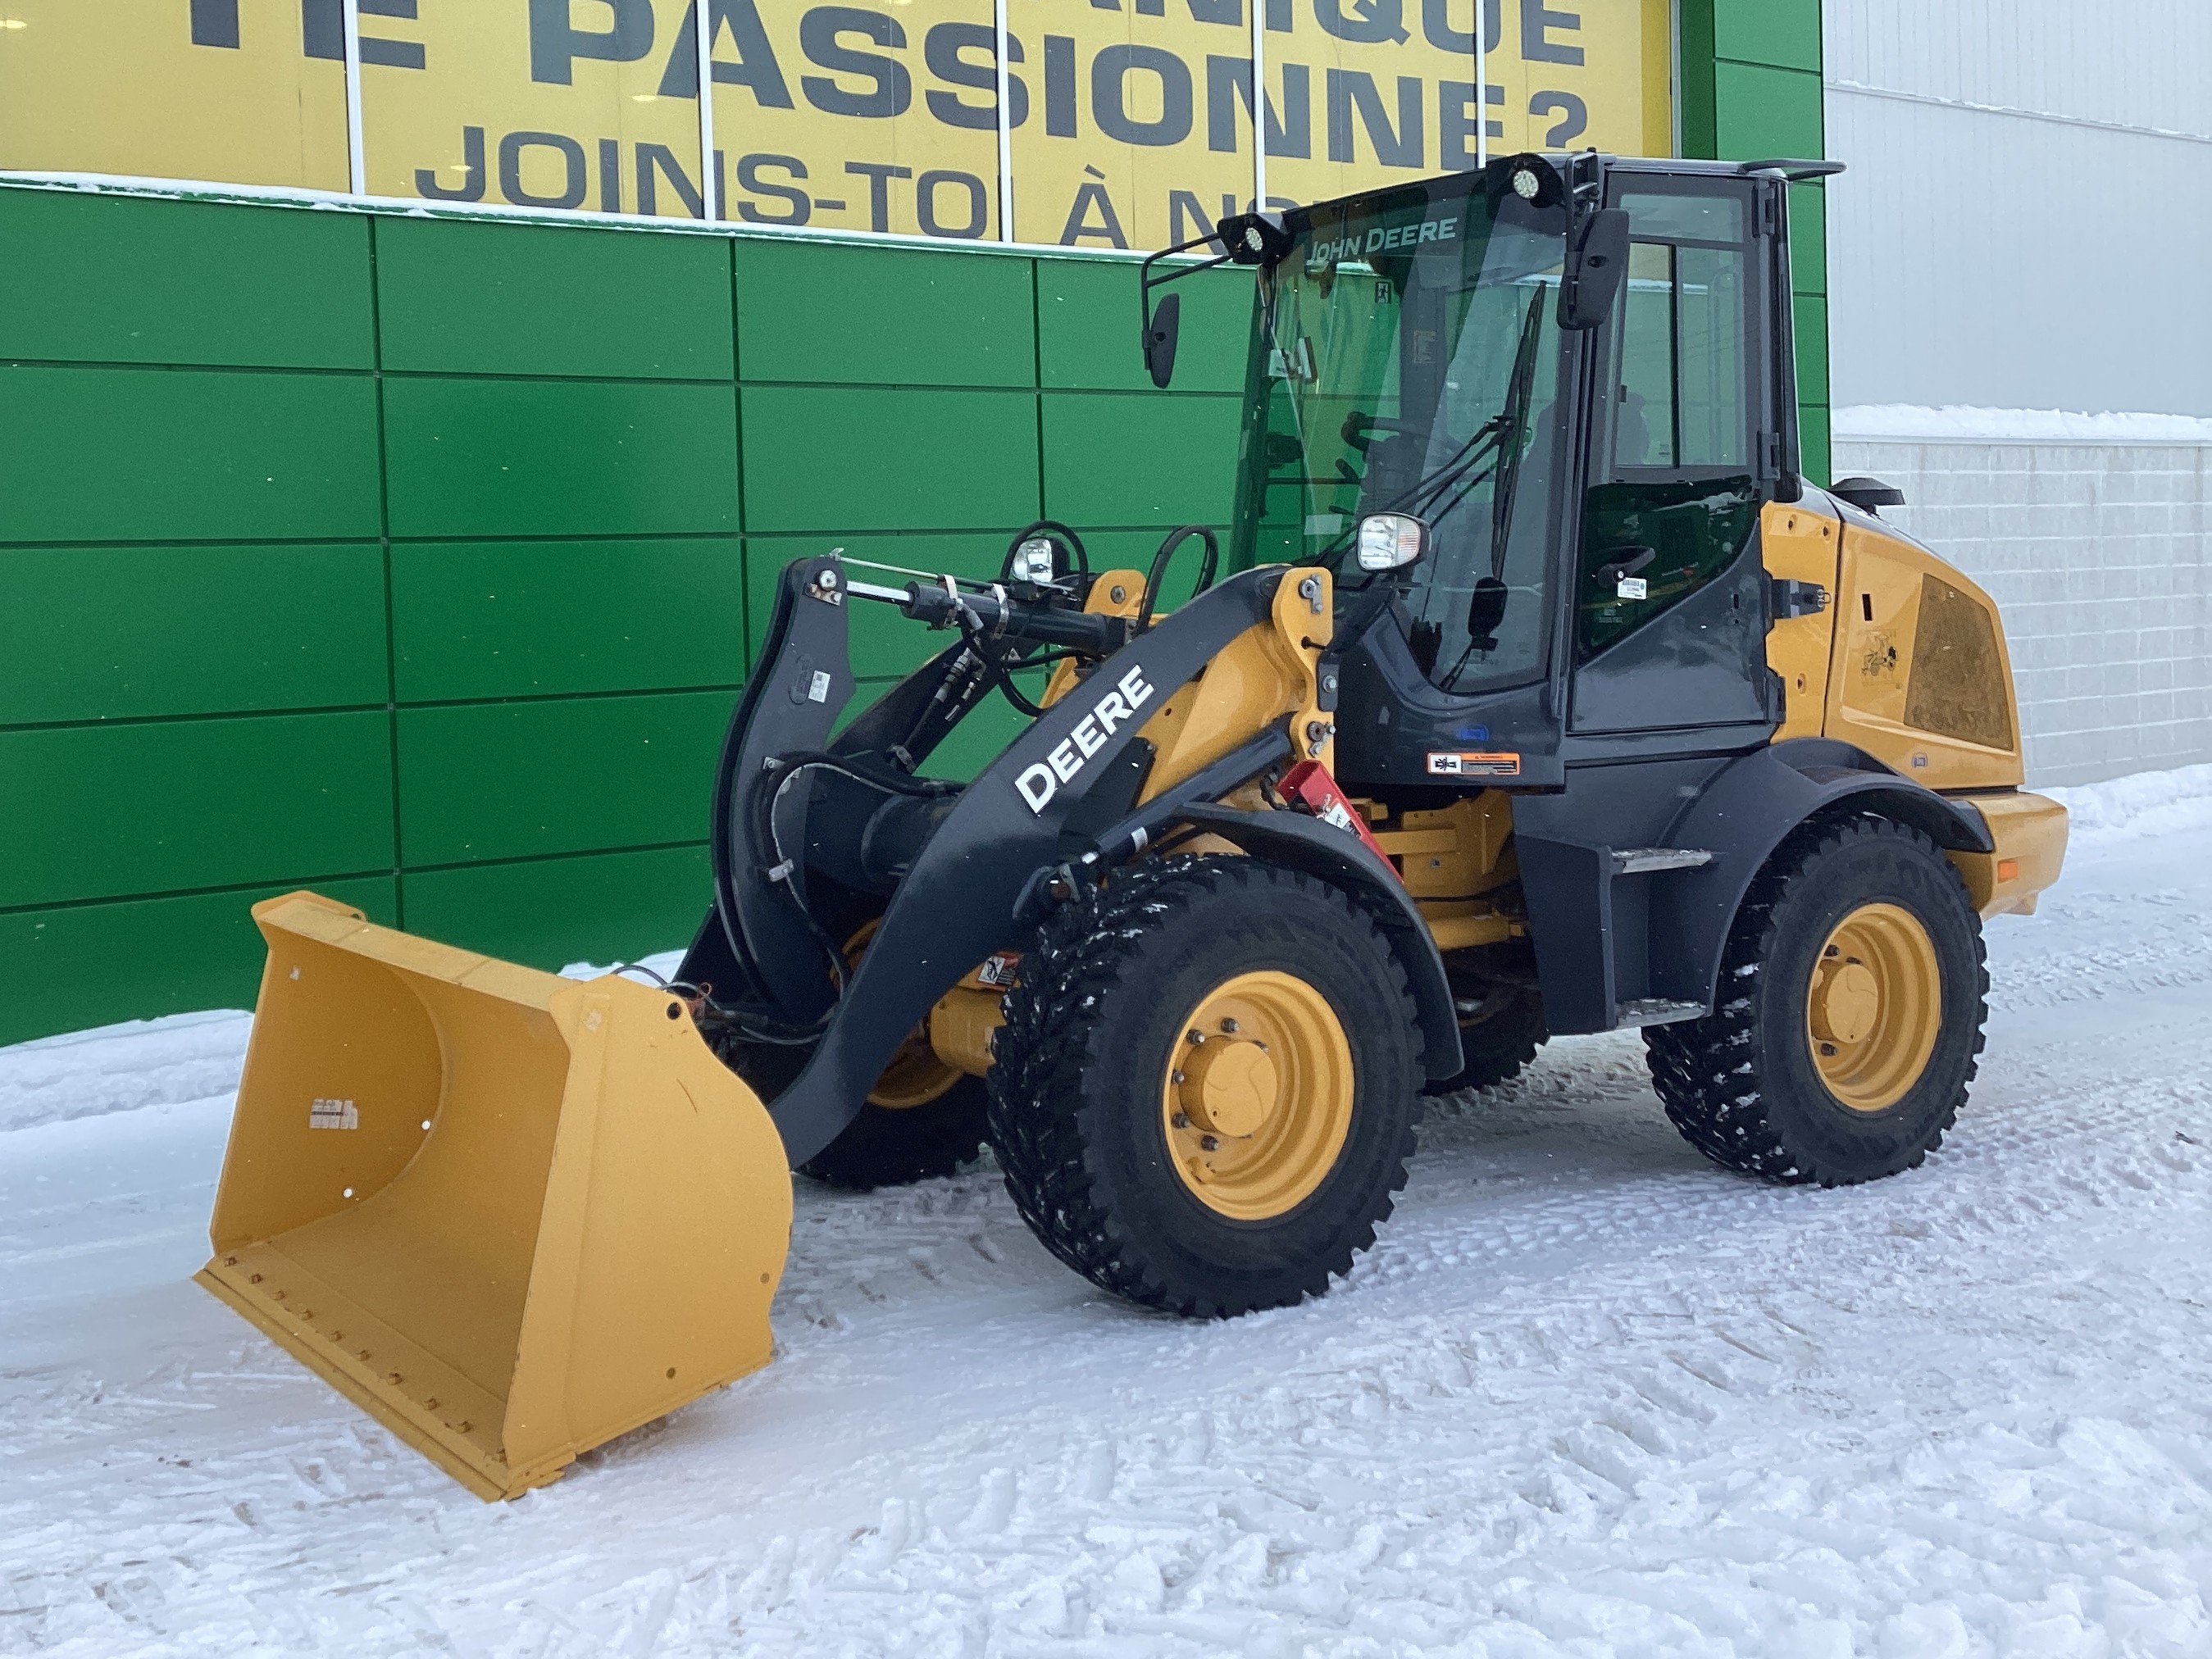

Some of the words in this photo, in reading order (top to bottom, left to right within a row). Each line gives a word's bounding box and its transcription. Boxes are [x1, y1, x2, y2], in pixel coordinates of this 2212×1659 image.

[415, 125, 1014, 243] JOINS-TO
[1059, 164, 1129, 249] À
[1312, 235, 1362, 261] JOHN
[1365, 217, 1458, 253] DEERE
[1014, 665, 1154, 814] DEERE
